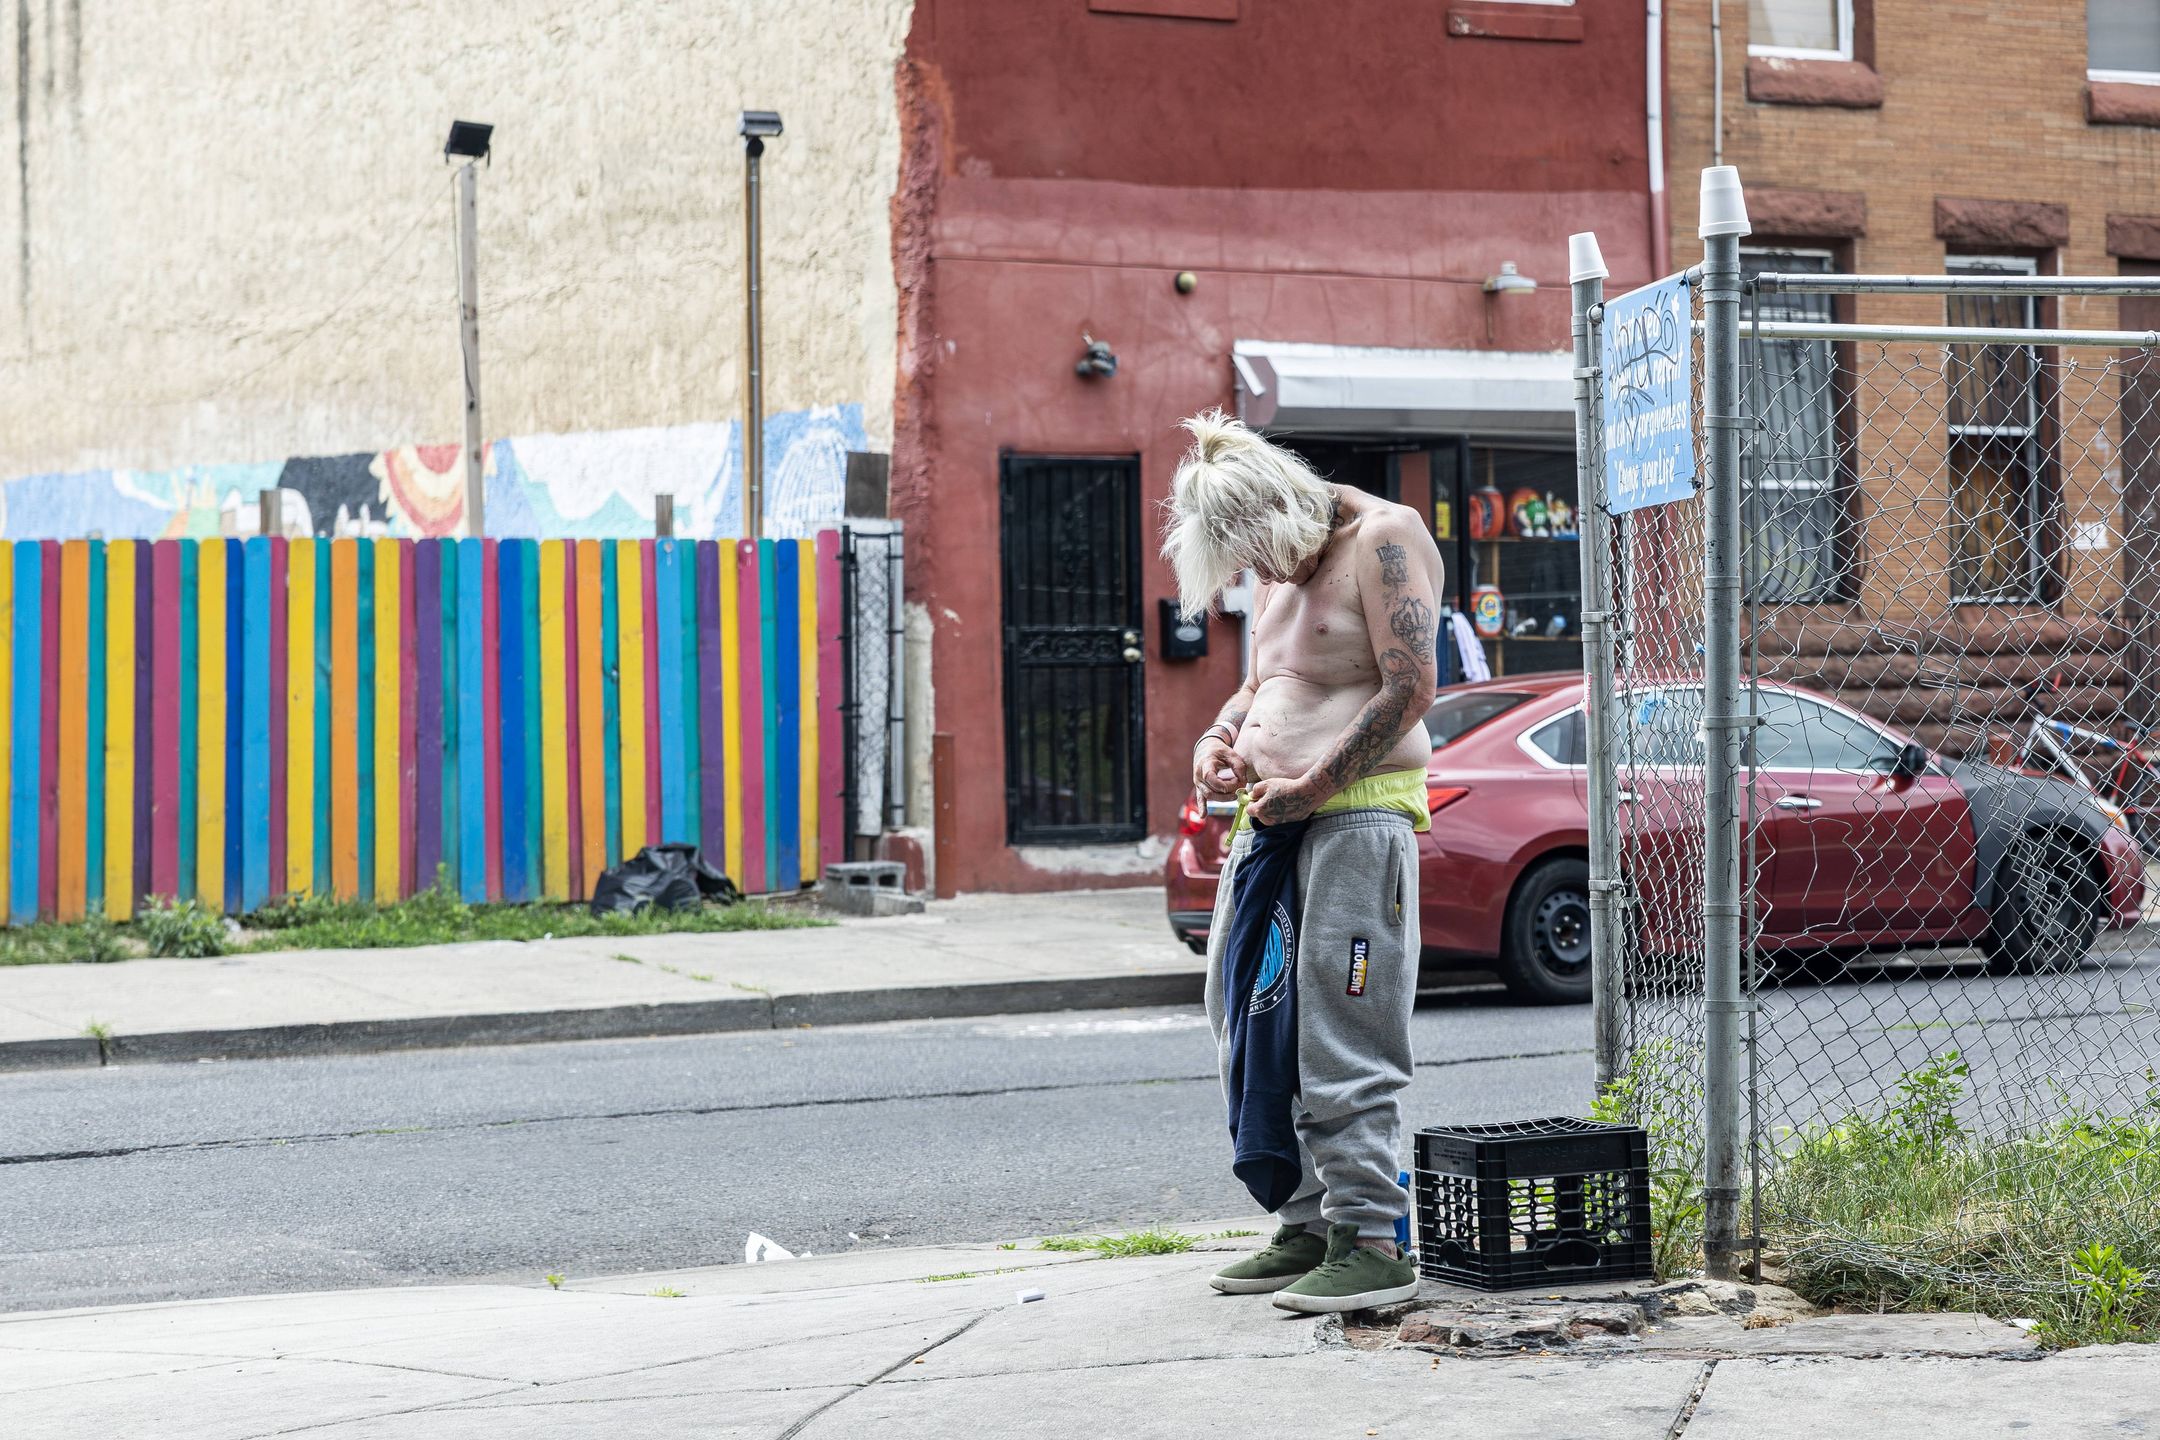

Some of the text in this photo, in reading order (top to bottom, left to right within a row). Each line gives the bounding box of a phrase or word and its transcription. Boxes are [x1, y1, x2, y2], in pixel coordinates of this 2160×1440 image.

[1636, 399, 1687, 452] forgiveness
[1276, 906, 1293, 943] PARADISE
[1350, 941, 1366, 994] JUST DO IT.
